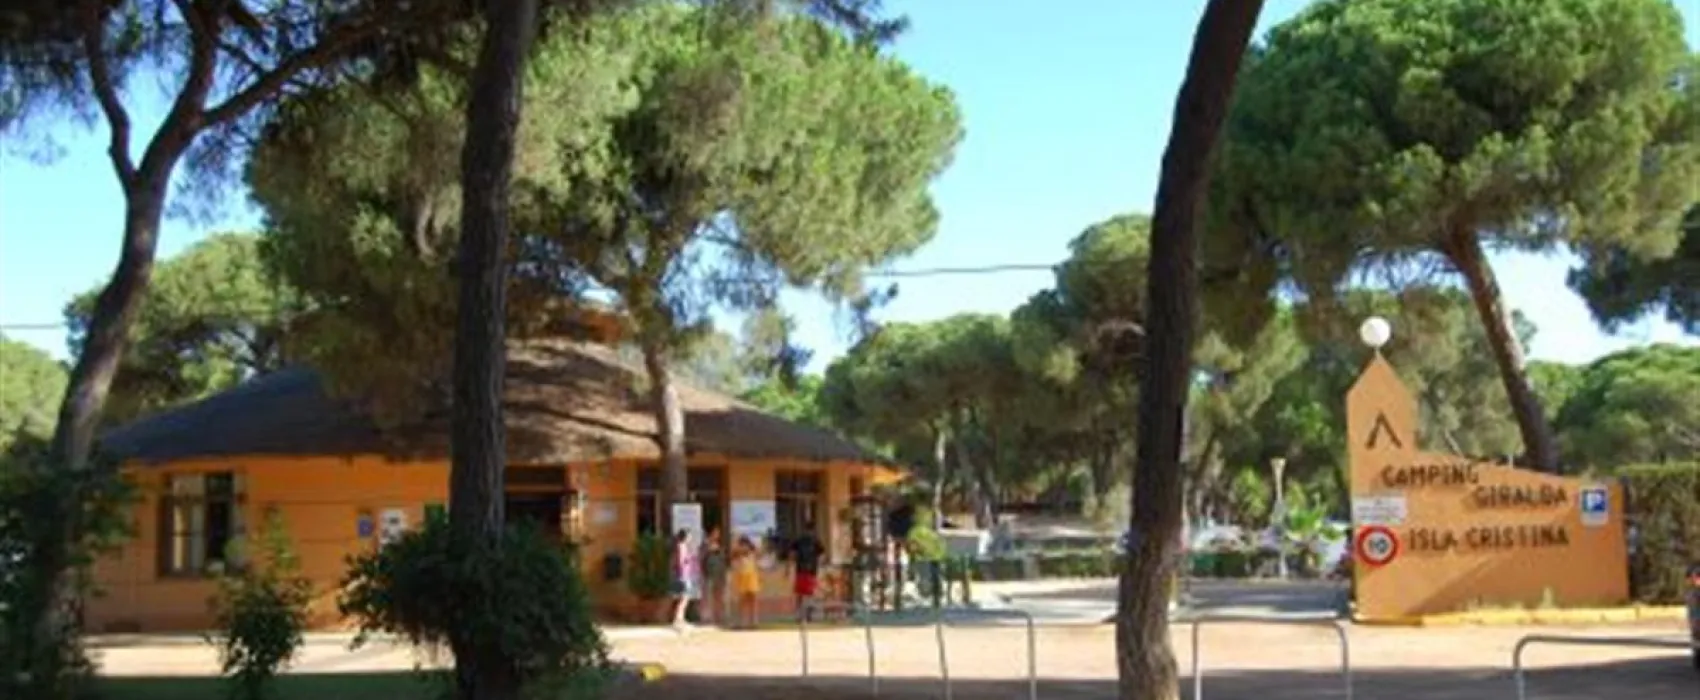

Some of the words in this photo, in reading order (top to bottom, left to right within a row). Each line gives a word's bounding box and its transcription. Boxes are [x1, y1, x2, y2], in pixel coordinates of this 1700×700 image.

[1380, 464, 1479, 487] CAMPING
[1472, 485, 1567, 508] GIRALDA
[1409, 527, 1459, 551] ISLA
[1465, 525, 1569, 549] CRISTINA
